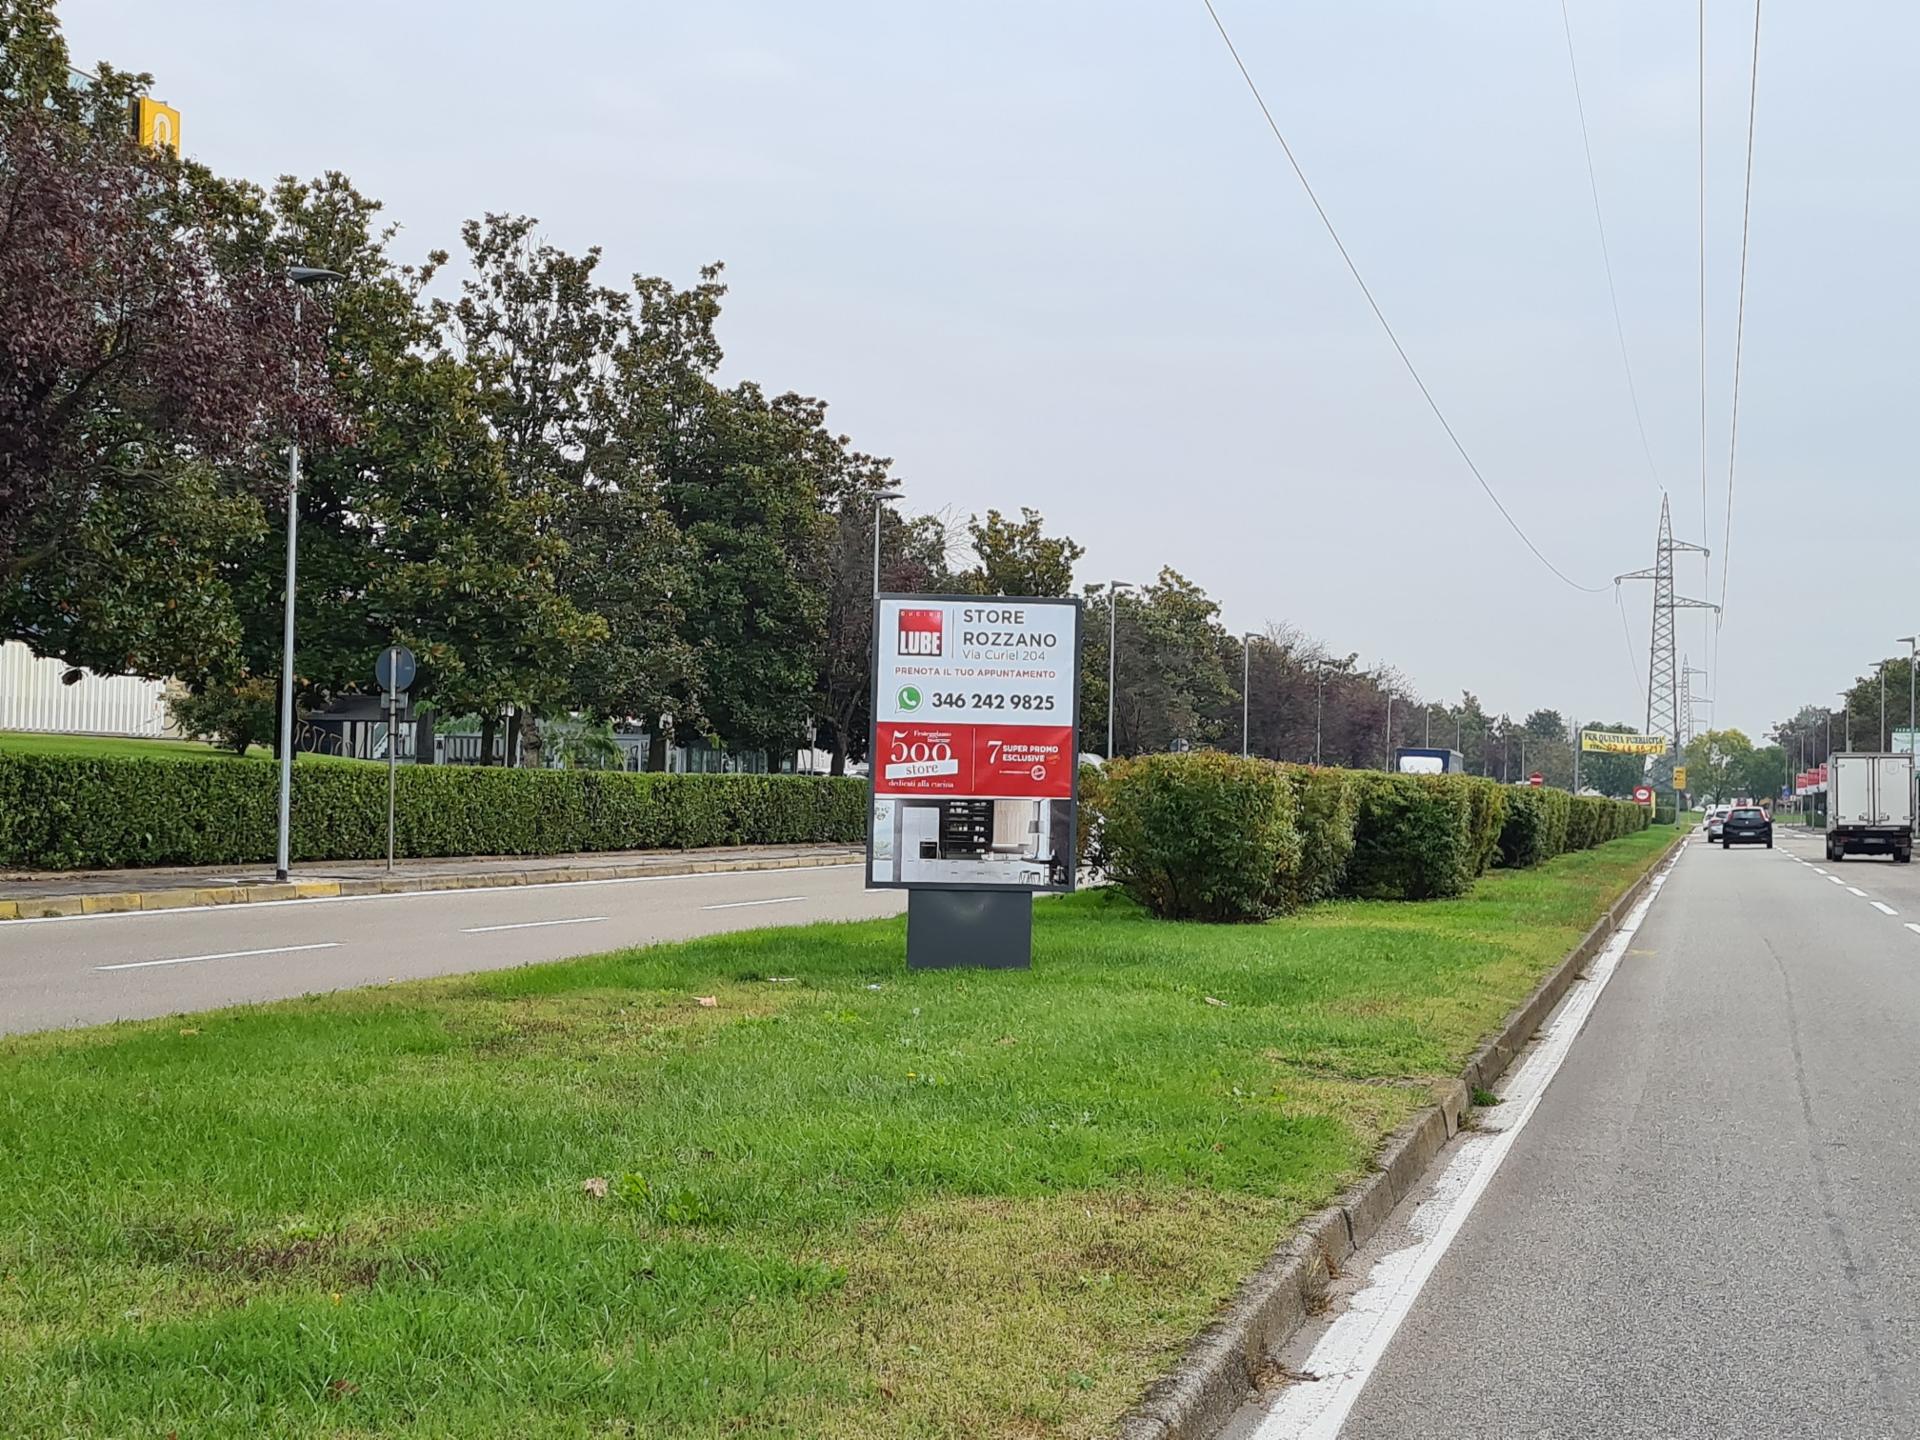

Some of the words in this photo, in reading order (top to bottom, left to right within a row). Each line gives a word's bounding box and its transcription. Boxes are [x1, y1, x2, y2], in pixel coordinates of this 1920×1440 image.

[963, 609, 1025, 625] STORE
[899, 630, 940, 655] LUBE
[963, 632, 1057, 648] ROZZANO
[962, 649, 983, 660] Via
[985, 650, 1019, 661] Curiel
[1022, 651, 1046, 662] 204
[895, 666, 940, 676] PRENOTA
[943, 668, 951, 677] IL
[955, 668, 974, 677] TUO
[977, 669, 1056, 679] APPUNTAMENTO
[931, 692, 966, 709] 346
[972, 693, 1005, 710] 242
[1010, 694, 1055, 711] 9825
[890, 730, 951, 763] 500
[986, 740, 1003, 765] 7
[1002, 745, 1028, 753] SUPER
[1029, 745, 1059, 754] PROMO
[1002, 753, 1045, 763] ESCLUSIVE
[905, 763, 939, 775] store
[888, 779, 916, 788] dedicati
[917, 779, 930, 788] alla
[931, 780, 954, 789] cucina
